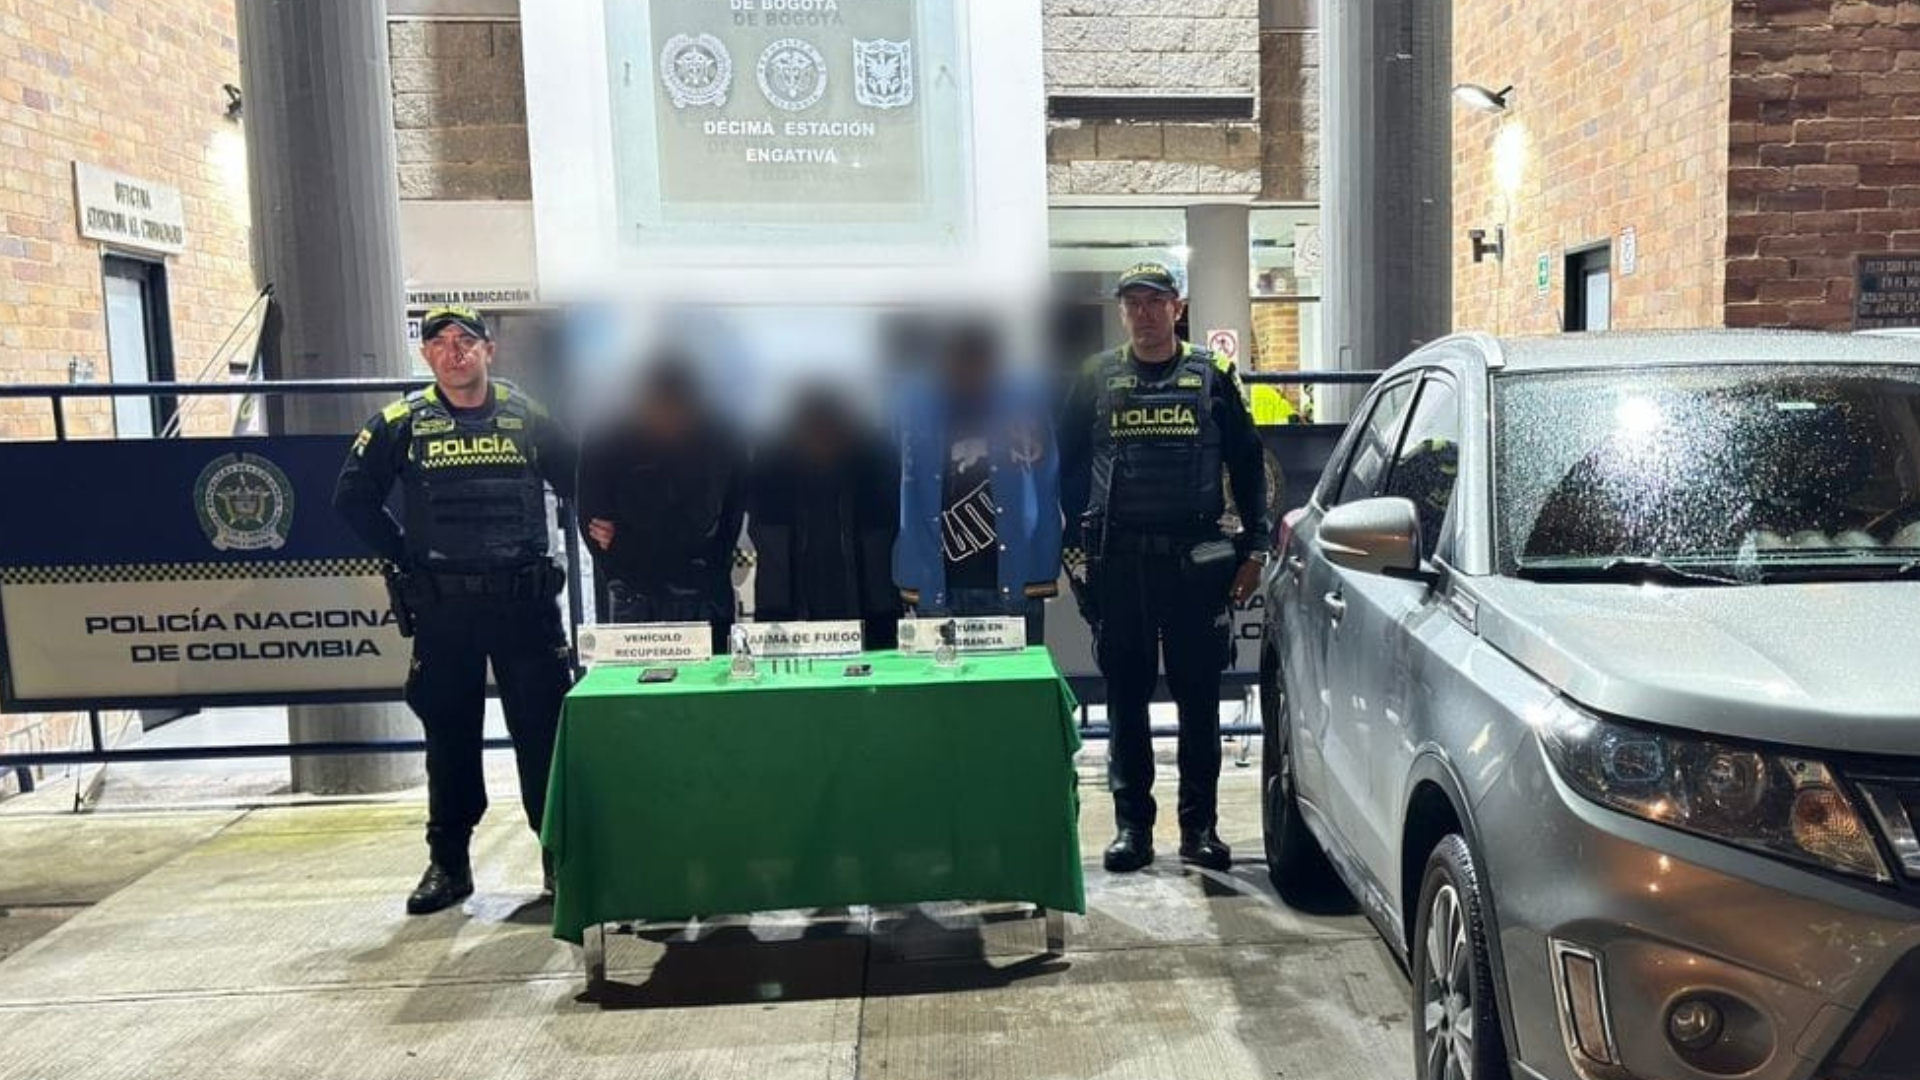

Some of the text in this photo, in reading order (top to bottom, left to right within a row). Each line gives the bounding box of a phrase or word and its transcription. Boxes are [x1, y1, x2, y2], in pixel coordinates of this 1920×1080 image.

[730, 0, 755, 10] DE
[785, 120, 875, 137] ESTACIÓN
[405, 291, 460, 304] ENTANILLA
[429, 433, 517, 457] POLICÍA
[86, 606, 400, 634] POLICÍA NACIONA
[792, 633, 811, 643] DE
[815, 631, 860, 642] FUEGO
[131, 639, 381, 662] DE COLOMBIA
[615, 647, 691, 658] RECUPERADO
